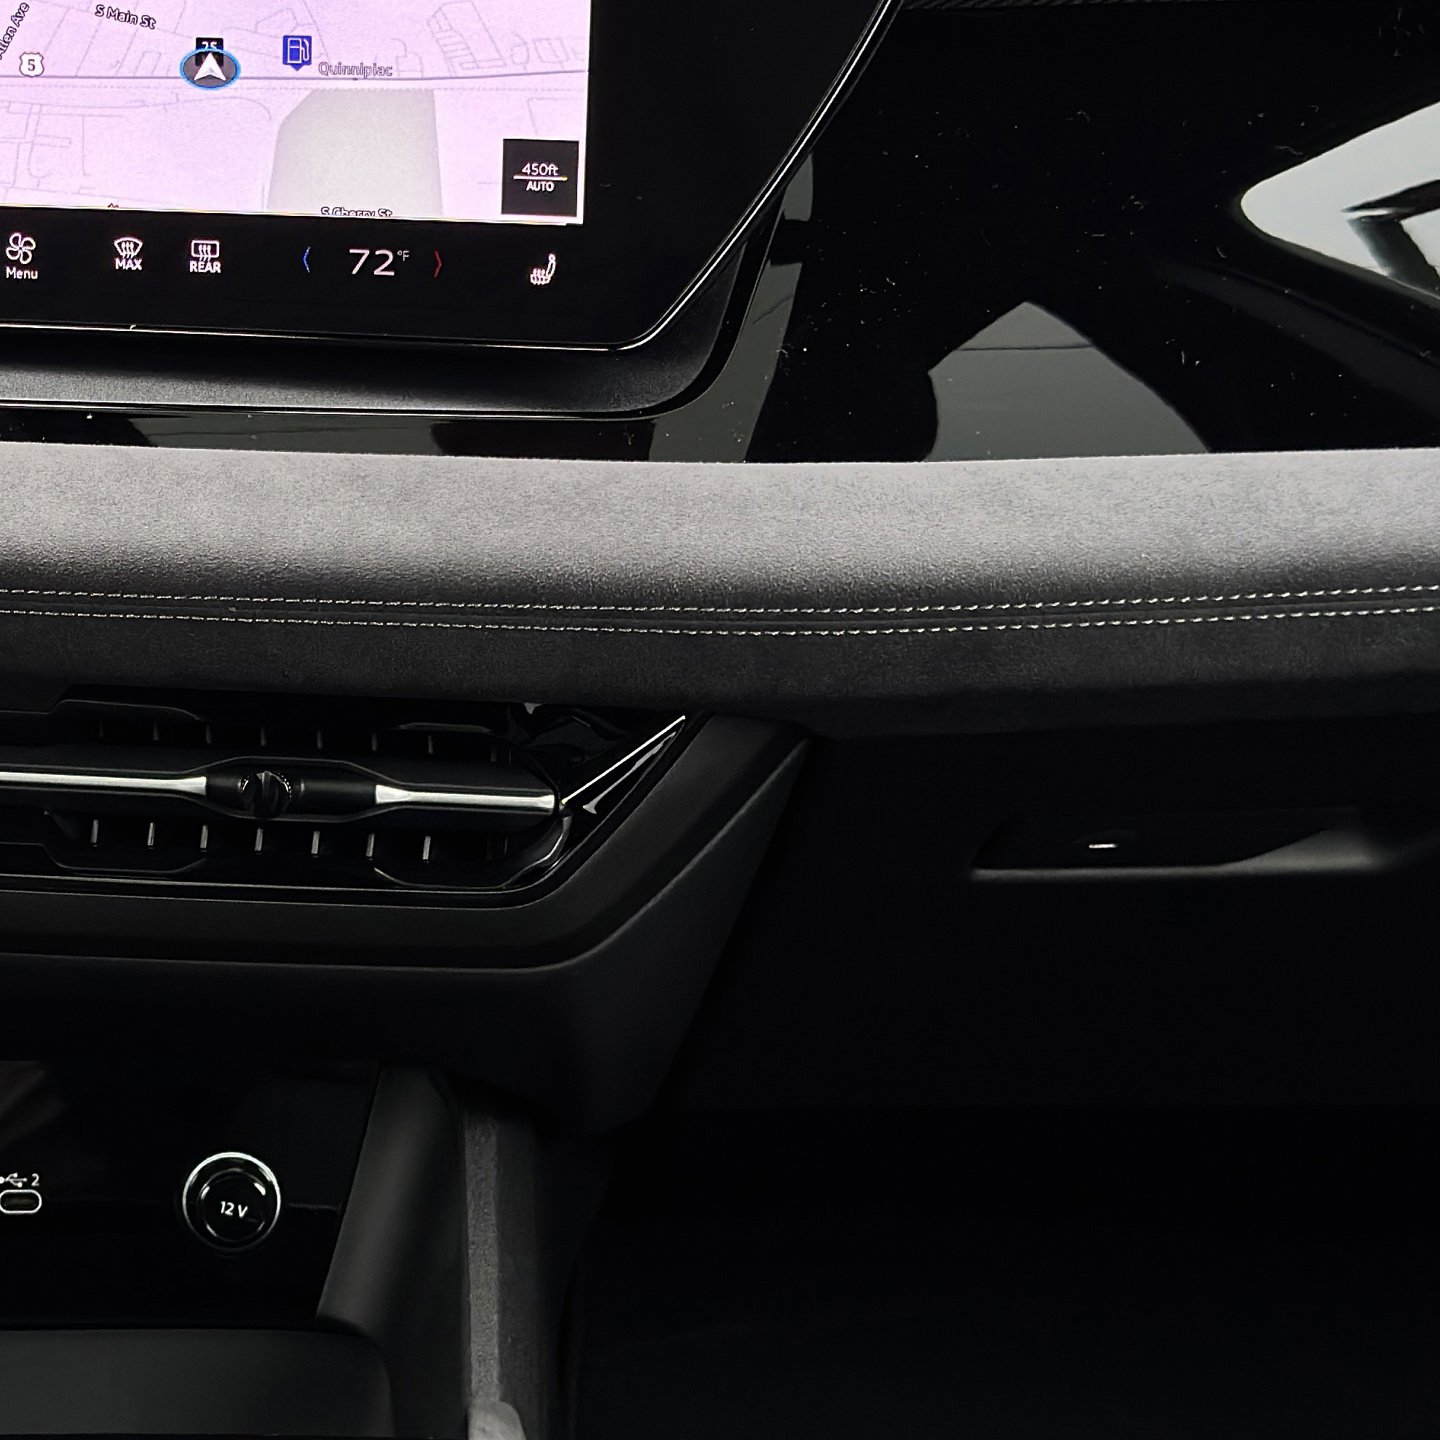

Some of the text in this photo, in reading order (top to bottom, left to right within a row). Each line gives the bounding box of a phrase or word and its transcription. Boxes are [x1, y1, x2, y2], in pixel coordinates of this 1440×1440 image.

[10, 2, 30, 27] Ave
[94, 4, 157, 30] S Main St
[27, 58, 36, 72] 5
[317, 61, 393, 79] Quinnipiac
[521, 163, 559, 176] 450ft
[526, 180, 555, 192] AUTO
[114, 258, 142, 271] MAX
[189, 261, 221, 274] REAR
[5, 266, 39, 280] Menu
[30, 1173, 40, 1188] 2
[220, 1200, 249, 1218] 12 V
